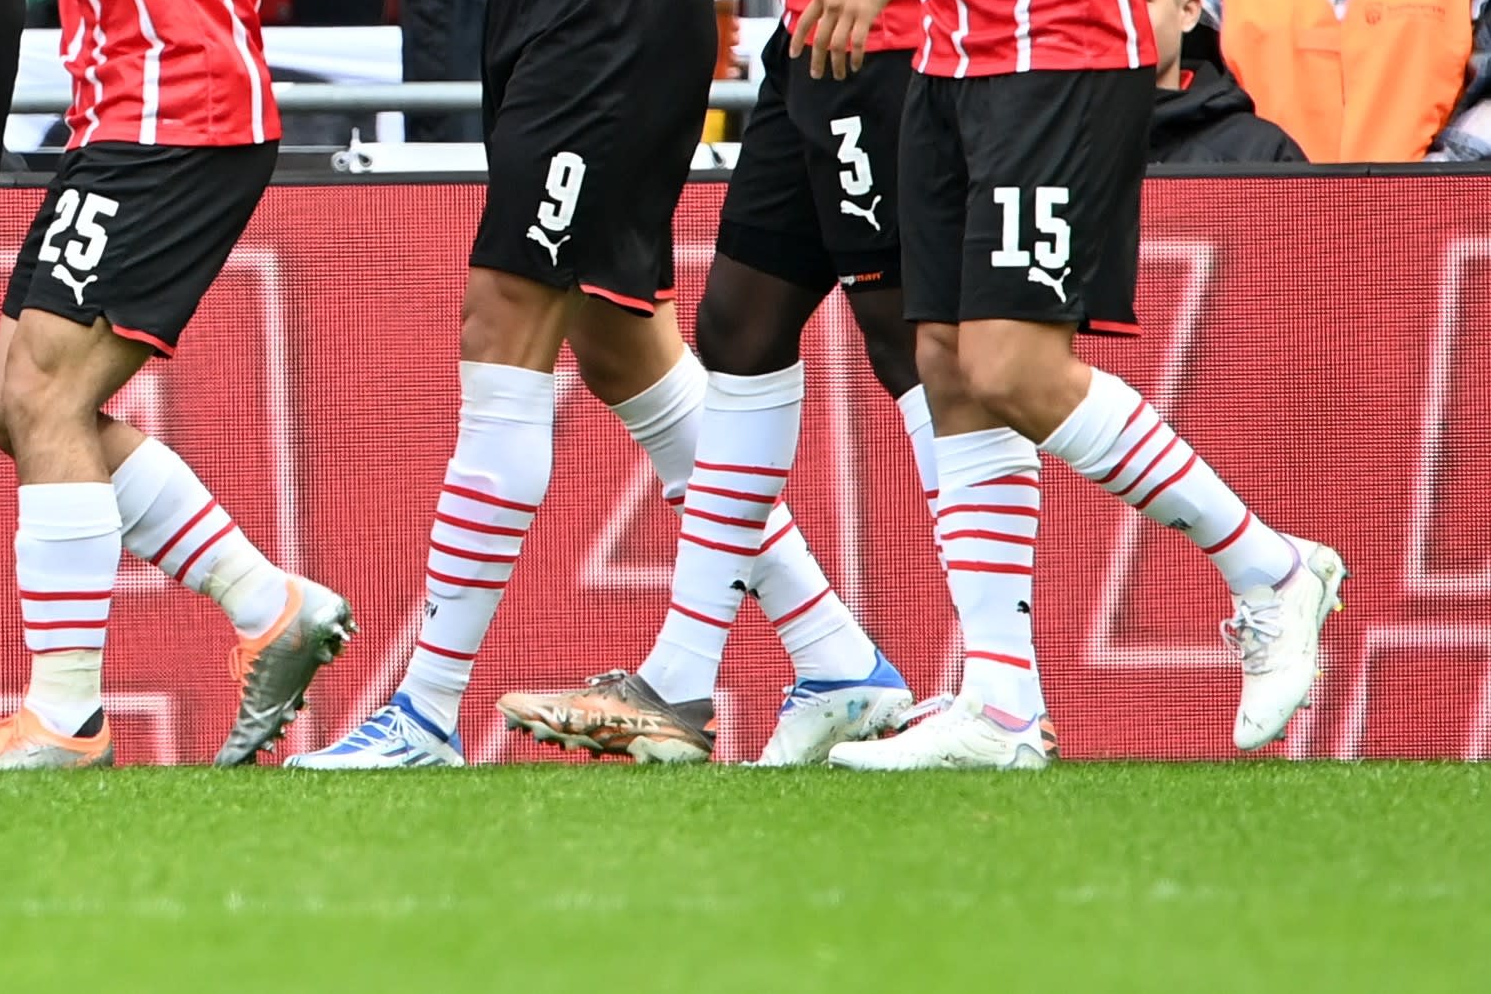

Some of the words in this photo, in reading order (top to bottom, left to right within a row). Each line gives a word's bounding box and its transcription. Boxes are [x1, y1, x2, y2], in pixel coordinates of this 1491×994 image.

[537, 151, 586, 231] 9
[830, 116, 873, 196] 3
[38, 188, 119, 271] 25
[991, 186, 1071, 269] 15
[553, 706, 660, 732] NEMESIS
